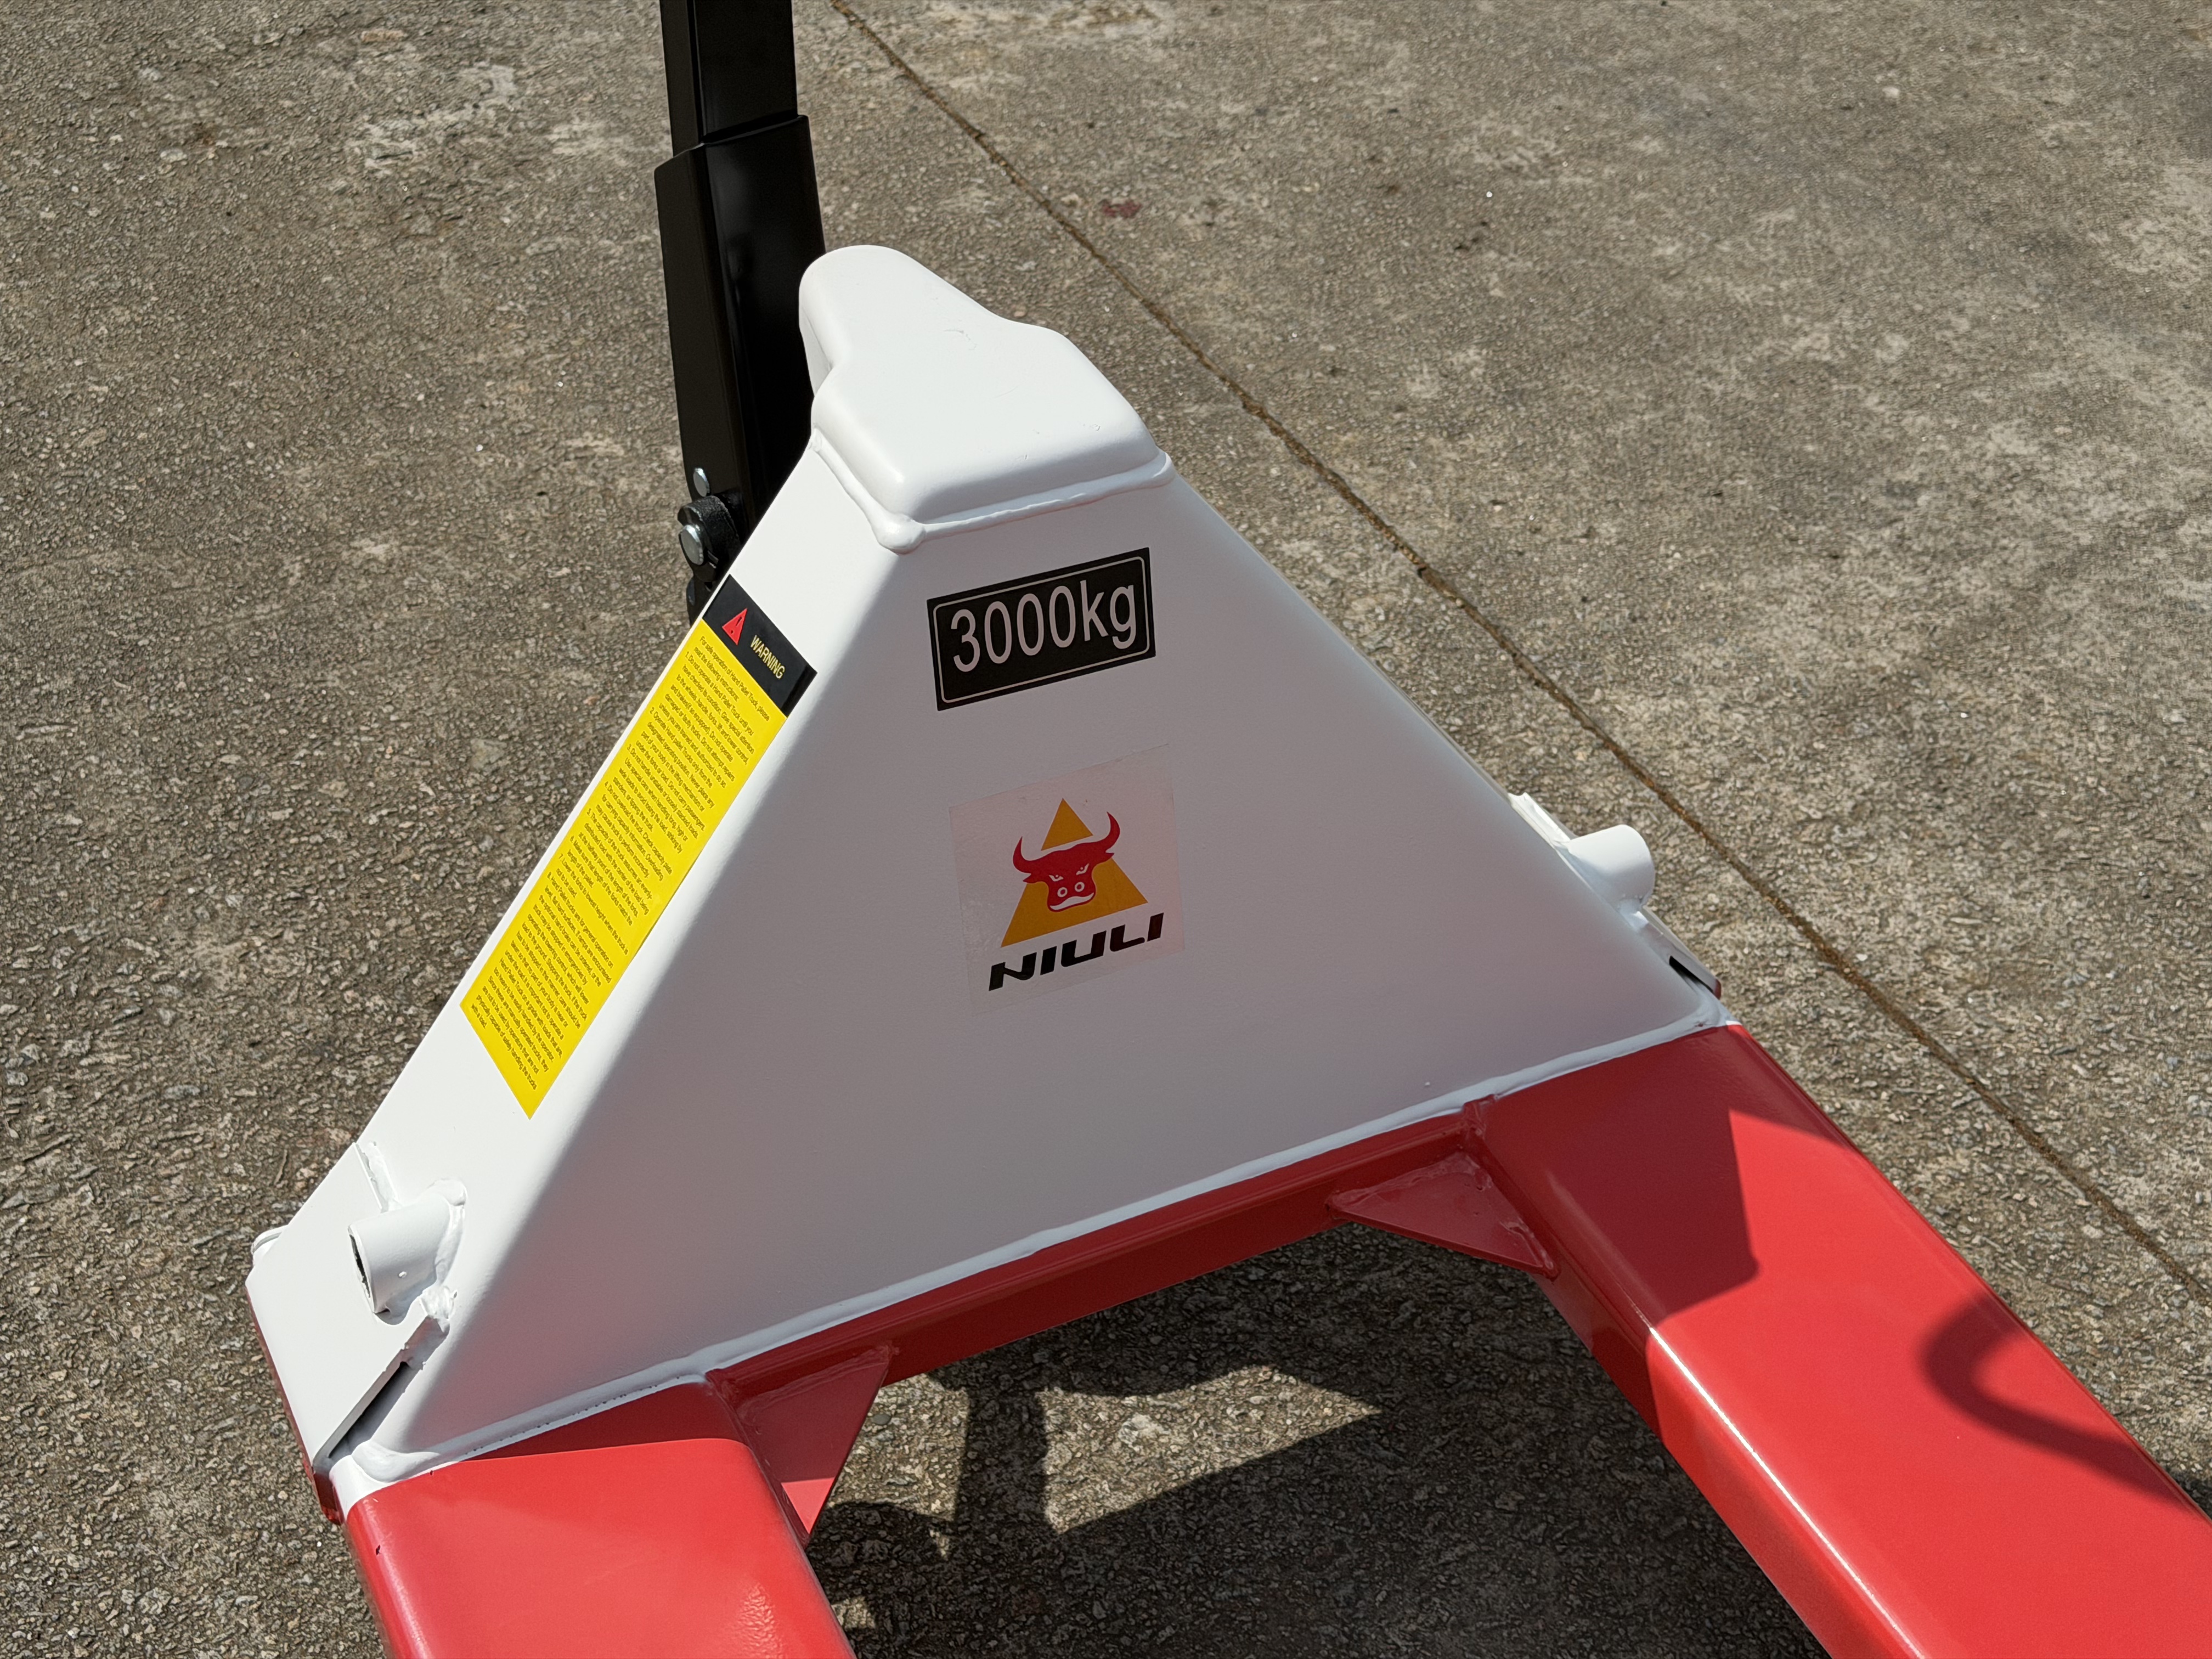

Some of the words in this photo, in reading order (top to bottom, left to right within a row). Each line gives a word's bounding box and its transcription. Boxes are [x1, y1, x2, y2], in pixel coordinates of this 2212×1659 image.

[748, 633, 787, 681] WARNING
[950, 579, 1137, 673] 3000kg
[988, 912, 1164, 992] NIULI
